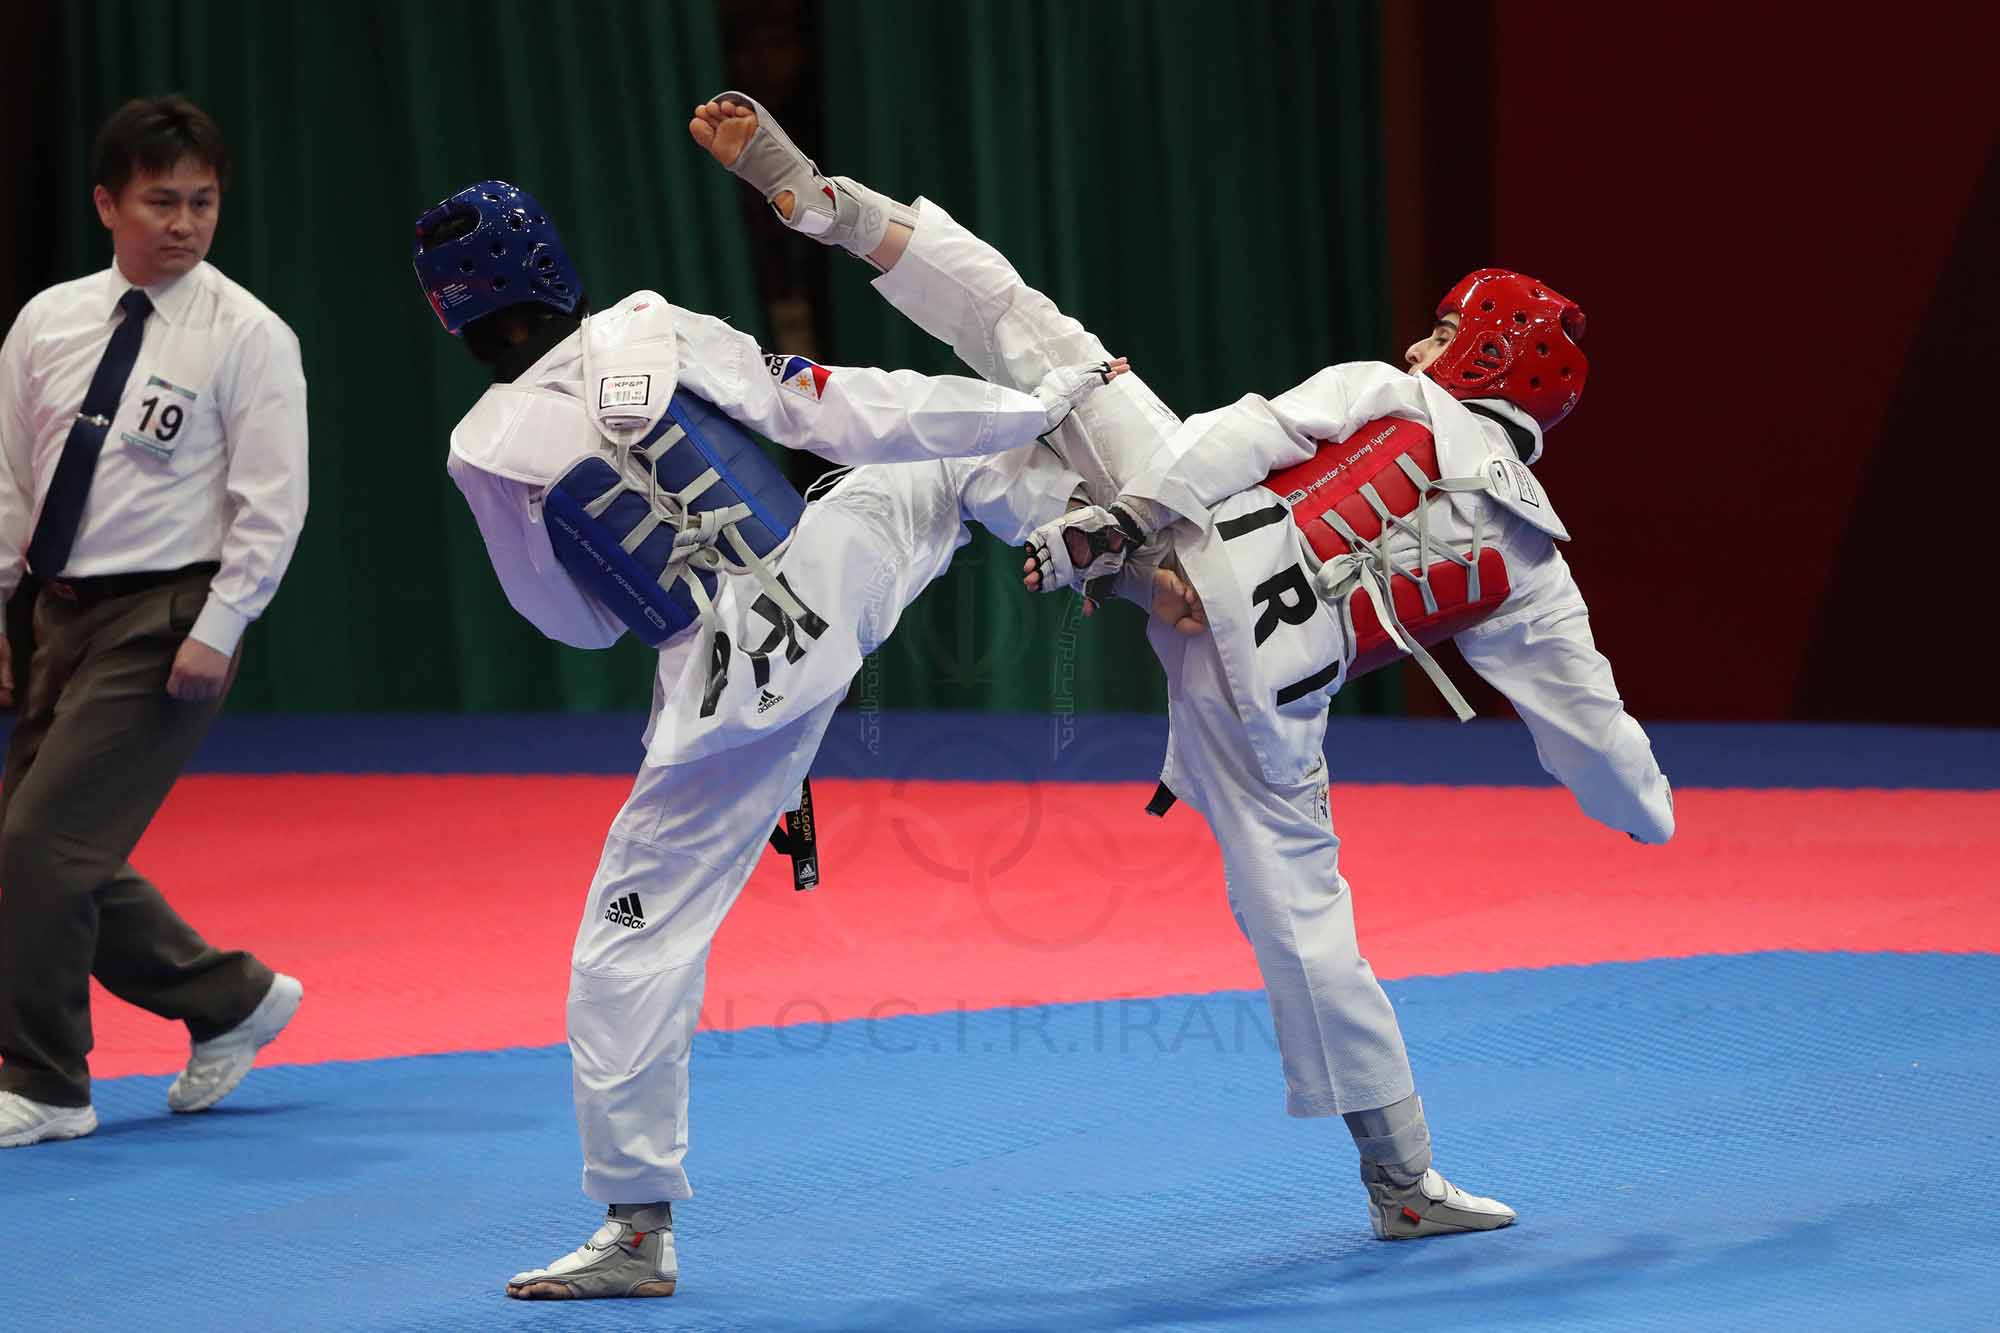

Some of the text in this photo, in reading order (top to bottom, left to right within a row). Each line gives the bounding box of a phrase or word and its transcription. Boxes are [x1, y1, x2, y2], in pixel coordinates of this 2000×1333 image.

[138, 395, 184, 442] 19
[1307, 467, 1338, 493] Protector
[1345, 444, 1373, 465] Scoring
[1371, 425, 1397, 446] System
[1214, 502, 1340, 707] IRI
[757, 695, 784, 714] adidas
[604, 909, 646, 929] adidas
